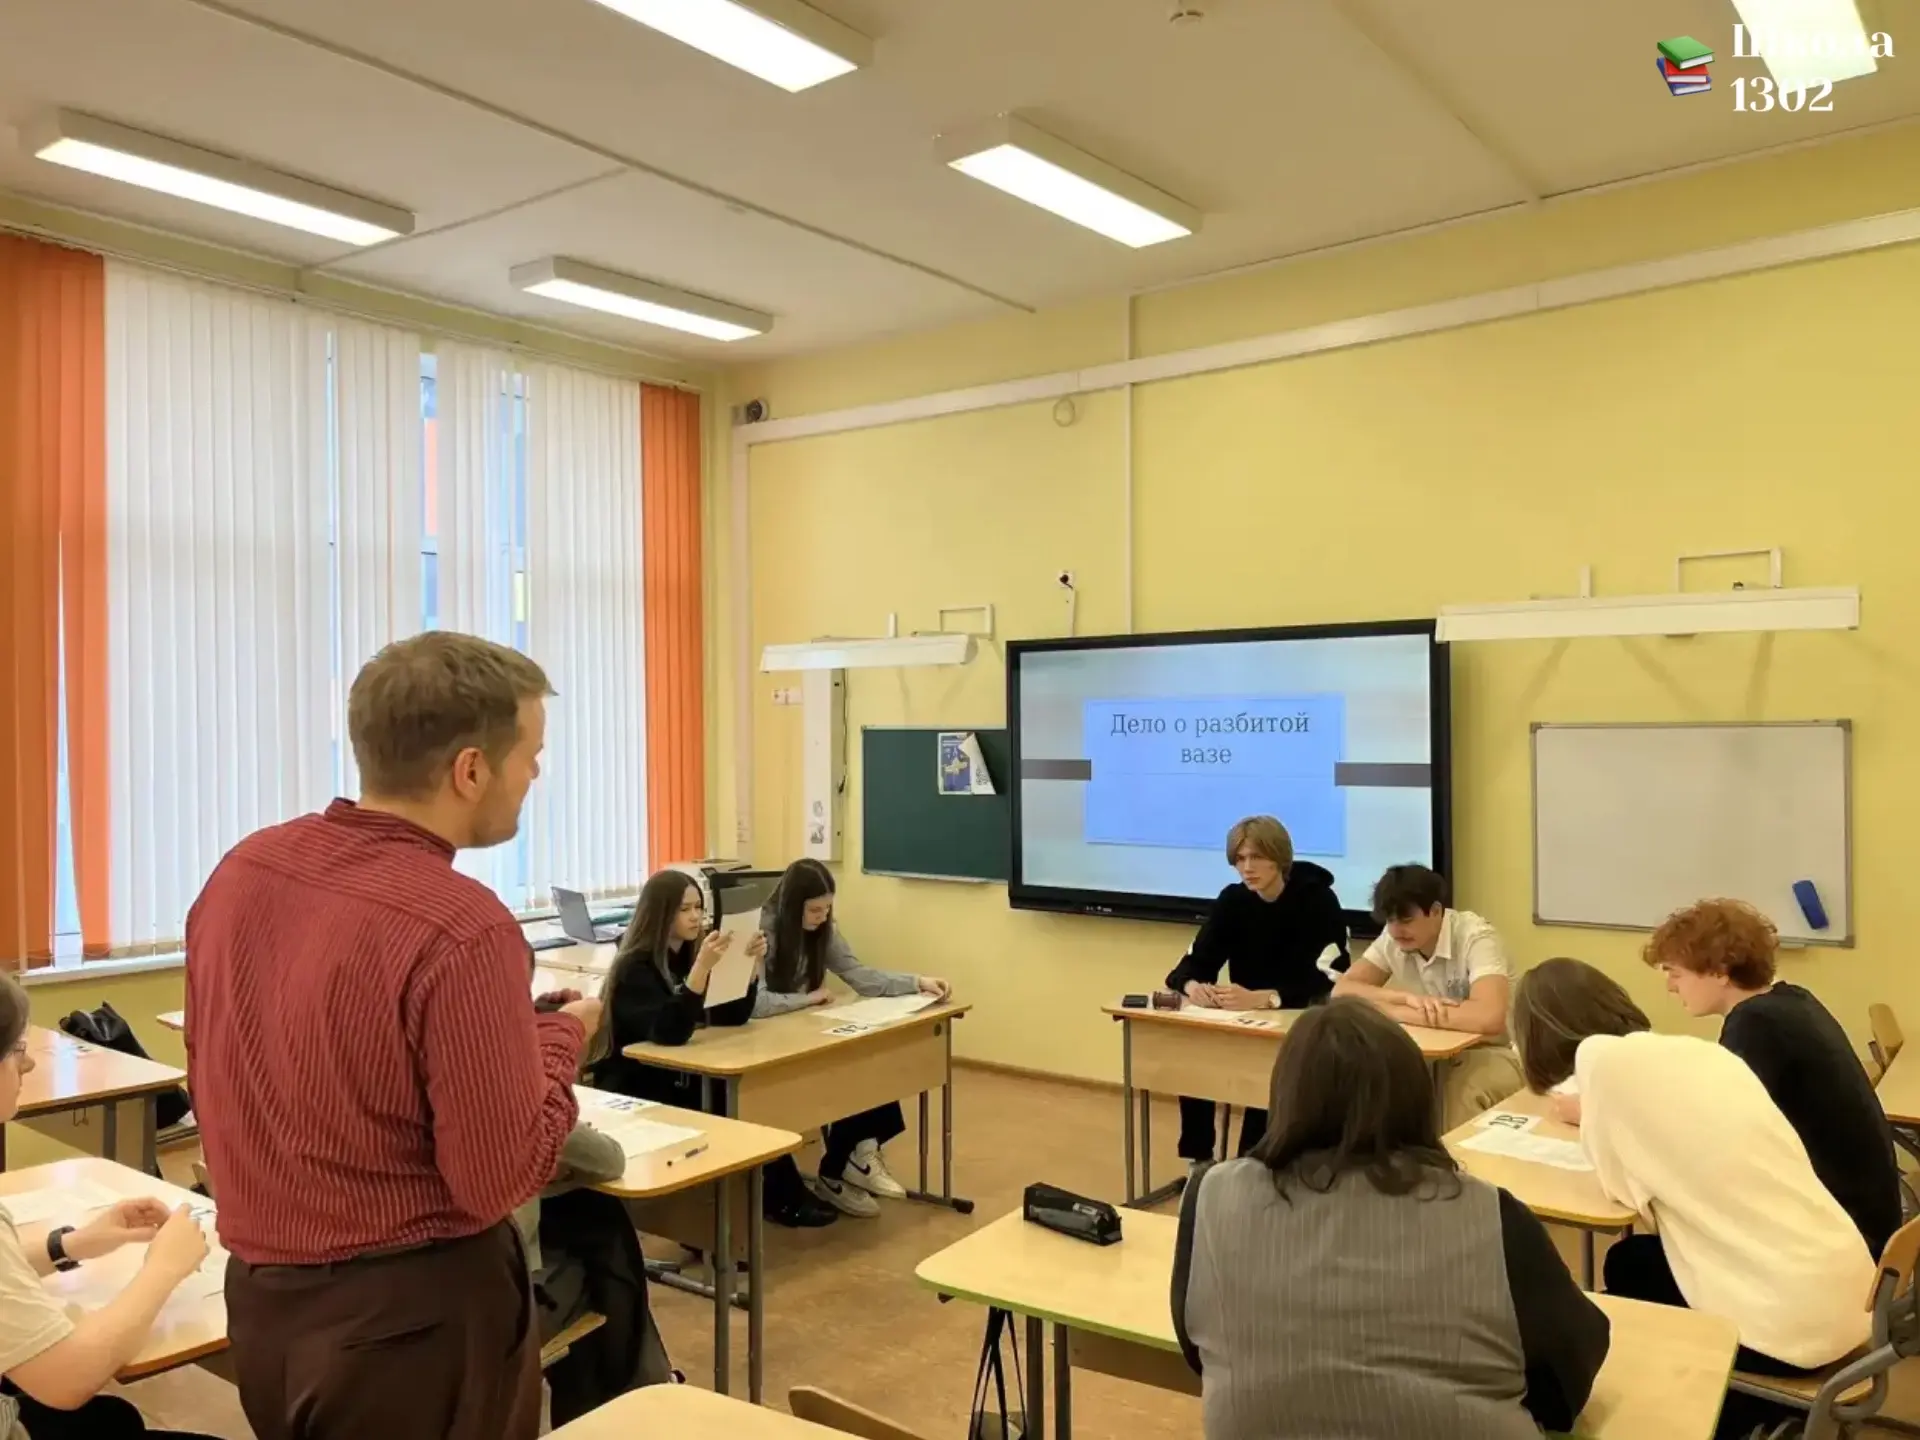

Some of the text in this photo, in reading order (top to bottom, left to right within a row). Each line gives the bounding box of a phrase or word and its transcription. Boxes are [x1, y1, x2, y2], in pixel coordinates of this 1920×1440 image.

[1110, 712, 1310, 738] Дело о разбитой
[1180, 747, 1232, 764] вазе
